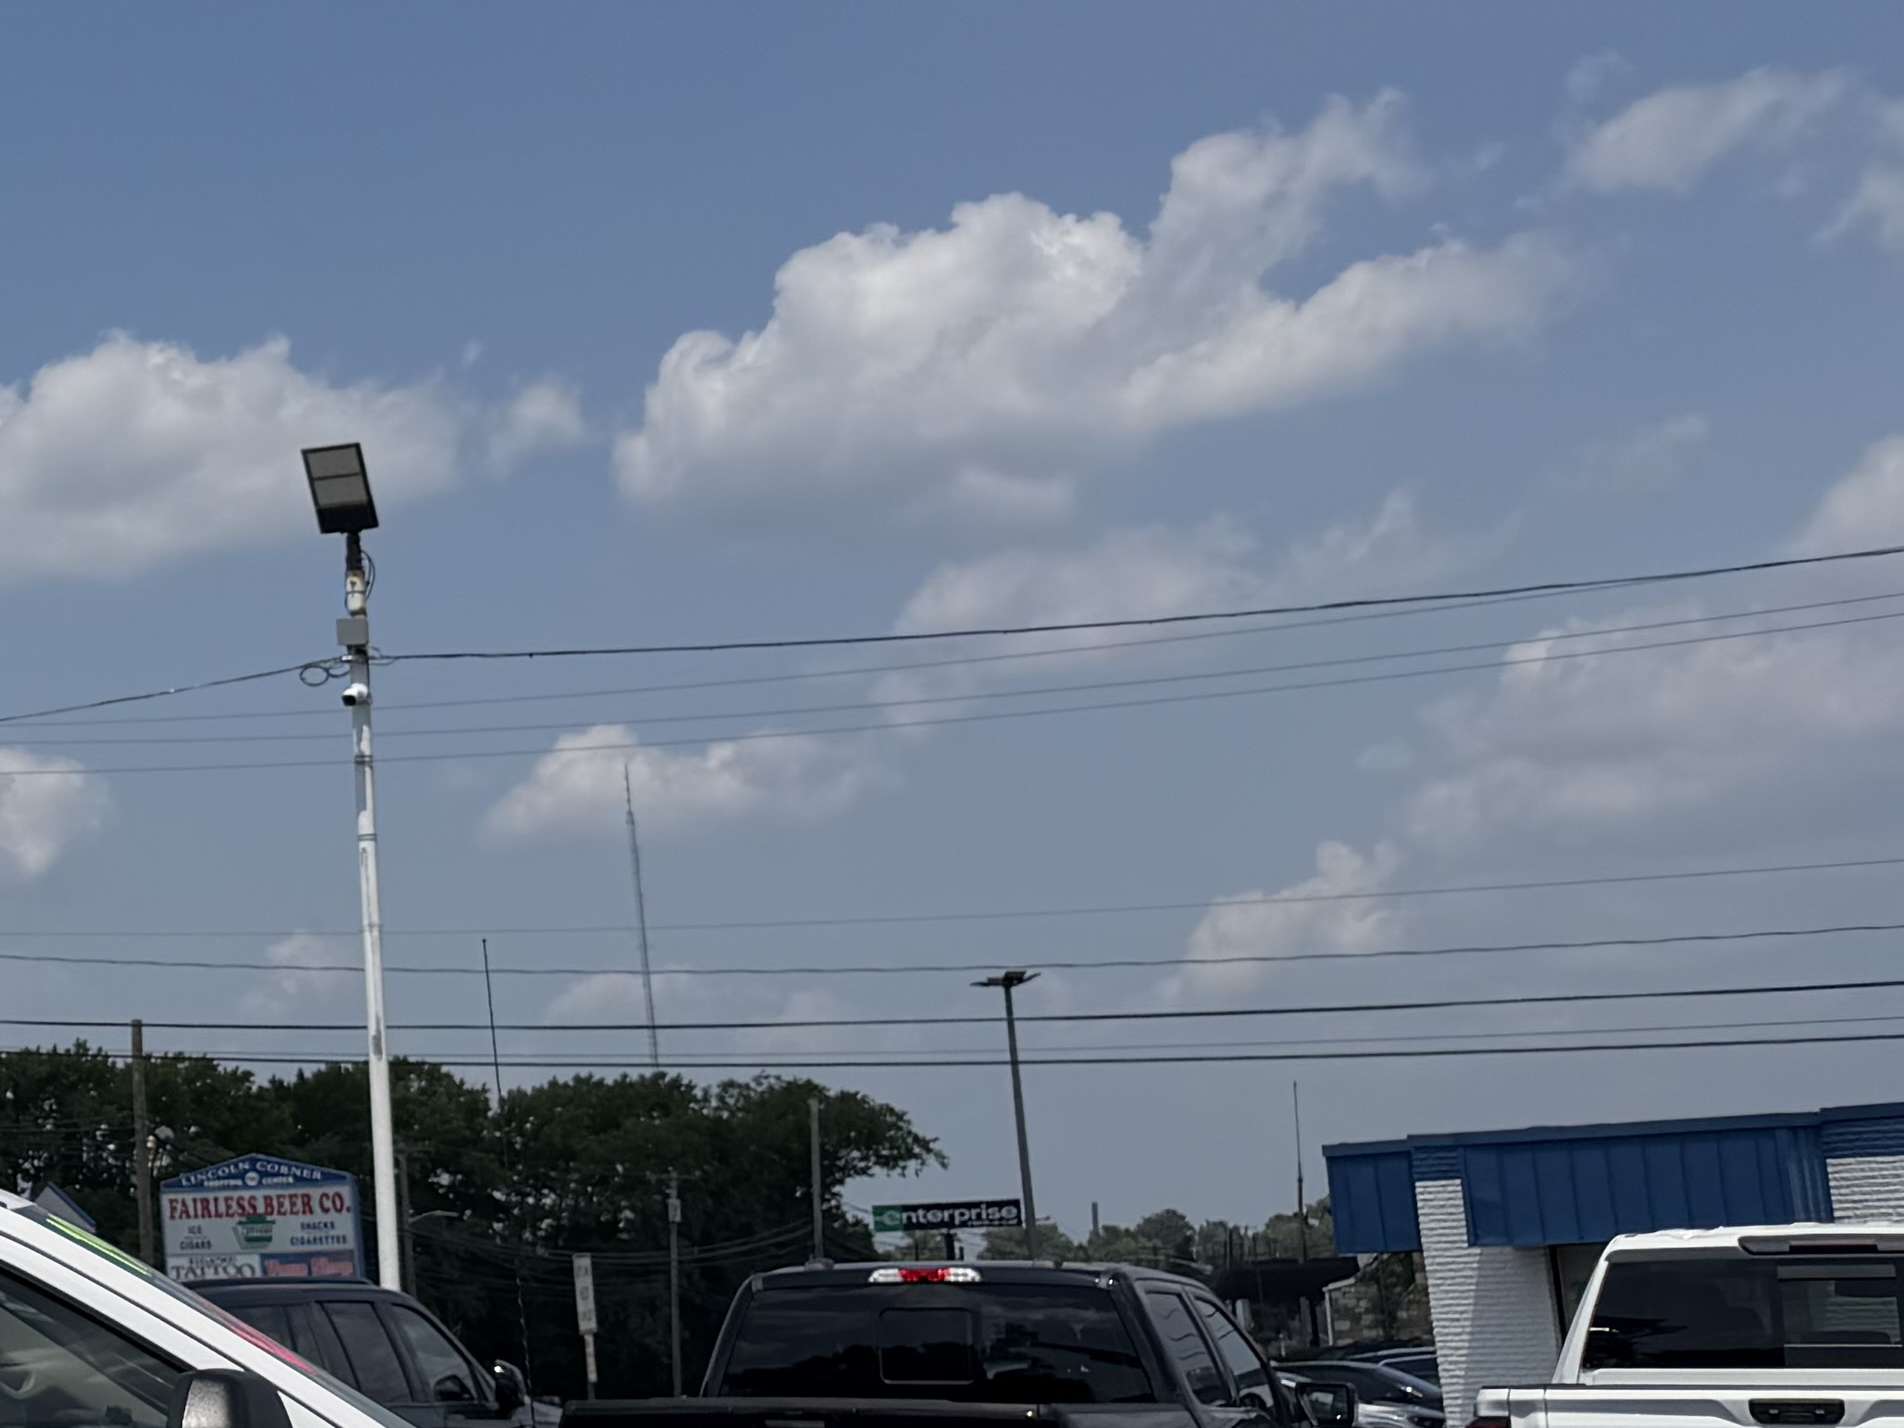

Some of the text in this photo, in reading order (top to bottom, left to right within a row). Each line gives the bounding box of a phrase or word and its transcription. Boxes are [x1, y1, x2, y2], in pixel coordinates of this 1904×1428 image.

[181, 1160, 323, 1187] LINCOLN CORNER
[168, 1191, 353, 1221] FAIRLESS BEER CO.
[883, 1203, 1018, 1227] enterprise
[300, 1221, 335, 1232] SNACKS
[179, 1240, 212, 1251] CIGARS
[289, 1234, 348, 1247] CIGARETTES
